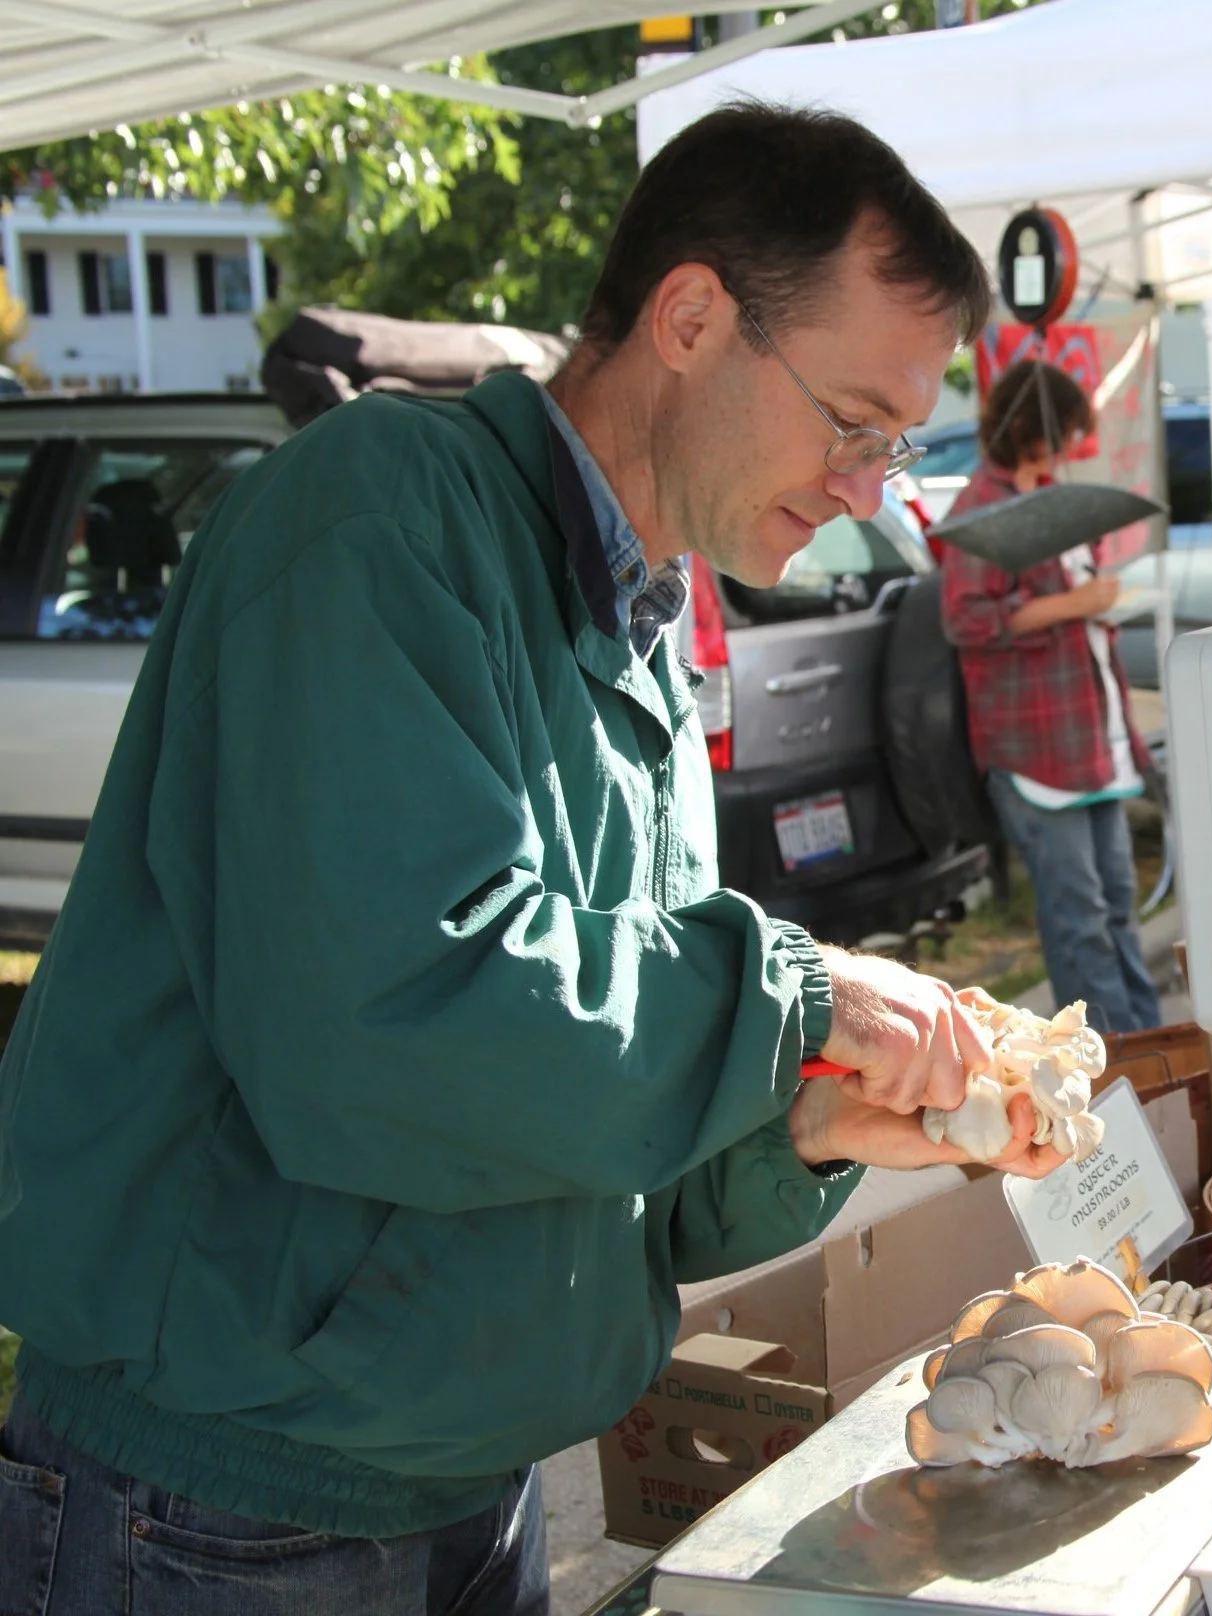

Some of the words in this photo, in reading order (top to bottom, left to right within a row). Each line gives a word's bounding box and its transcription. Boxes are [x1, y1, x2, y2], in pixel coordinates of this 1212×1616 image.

[1077, 1153, 1119, 1196] OYSTER
[1070, 1159, 1140, 1229] MUSHROOMS
[684, 1386, 747, 1412] PORTABELLA
[774, 1401, 814, 1423] OYSTER
[640, 1476, 688, 1503] STORE
[692, 1488, 710, 1505] AT
[642, 1501, 654, 1515] 5
